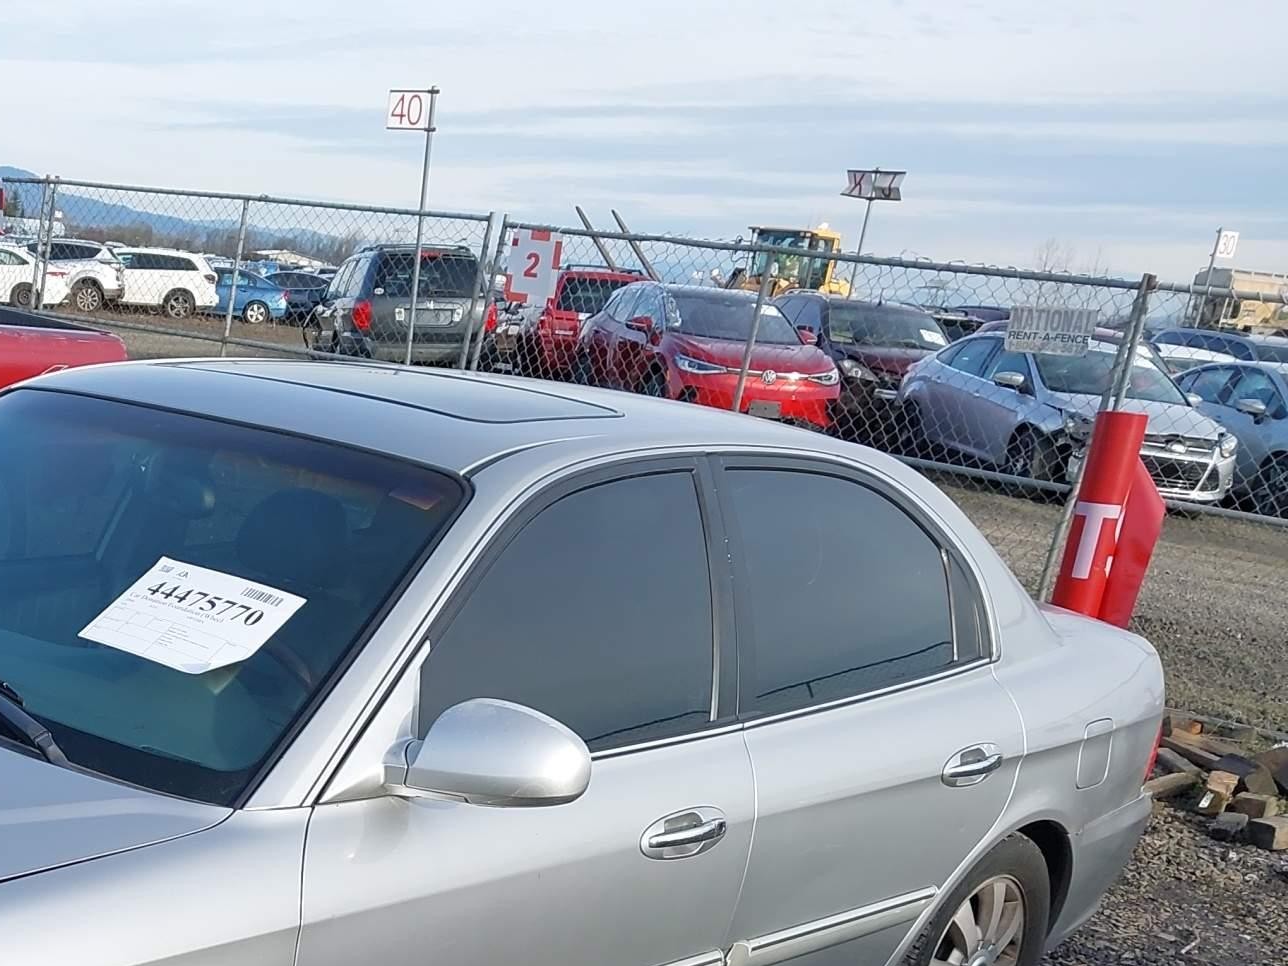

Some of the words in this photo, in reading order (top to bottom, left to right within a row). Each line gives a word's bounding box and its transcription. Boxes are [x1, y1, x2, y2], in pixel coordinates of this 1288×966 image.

[390, 93, 423, 126] 40
[523, 252, 540, 278] 2
[1010, 305, 1094, 333] NATIONAL
[1008, 330, 1090, 345] RENT-A-FENCE
[147, 581, 265, 626] 44475770
